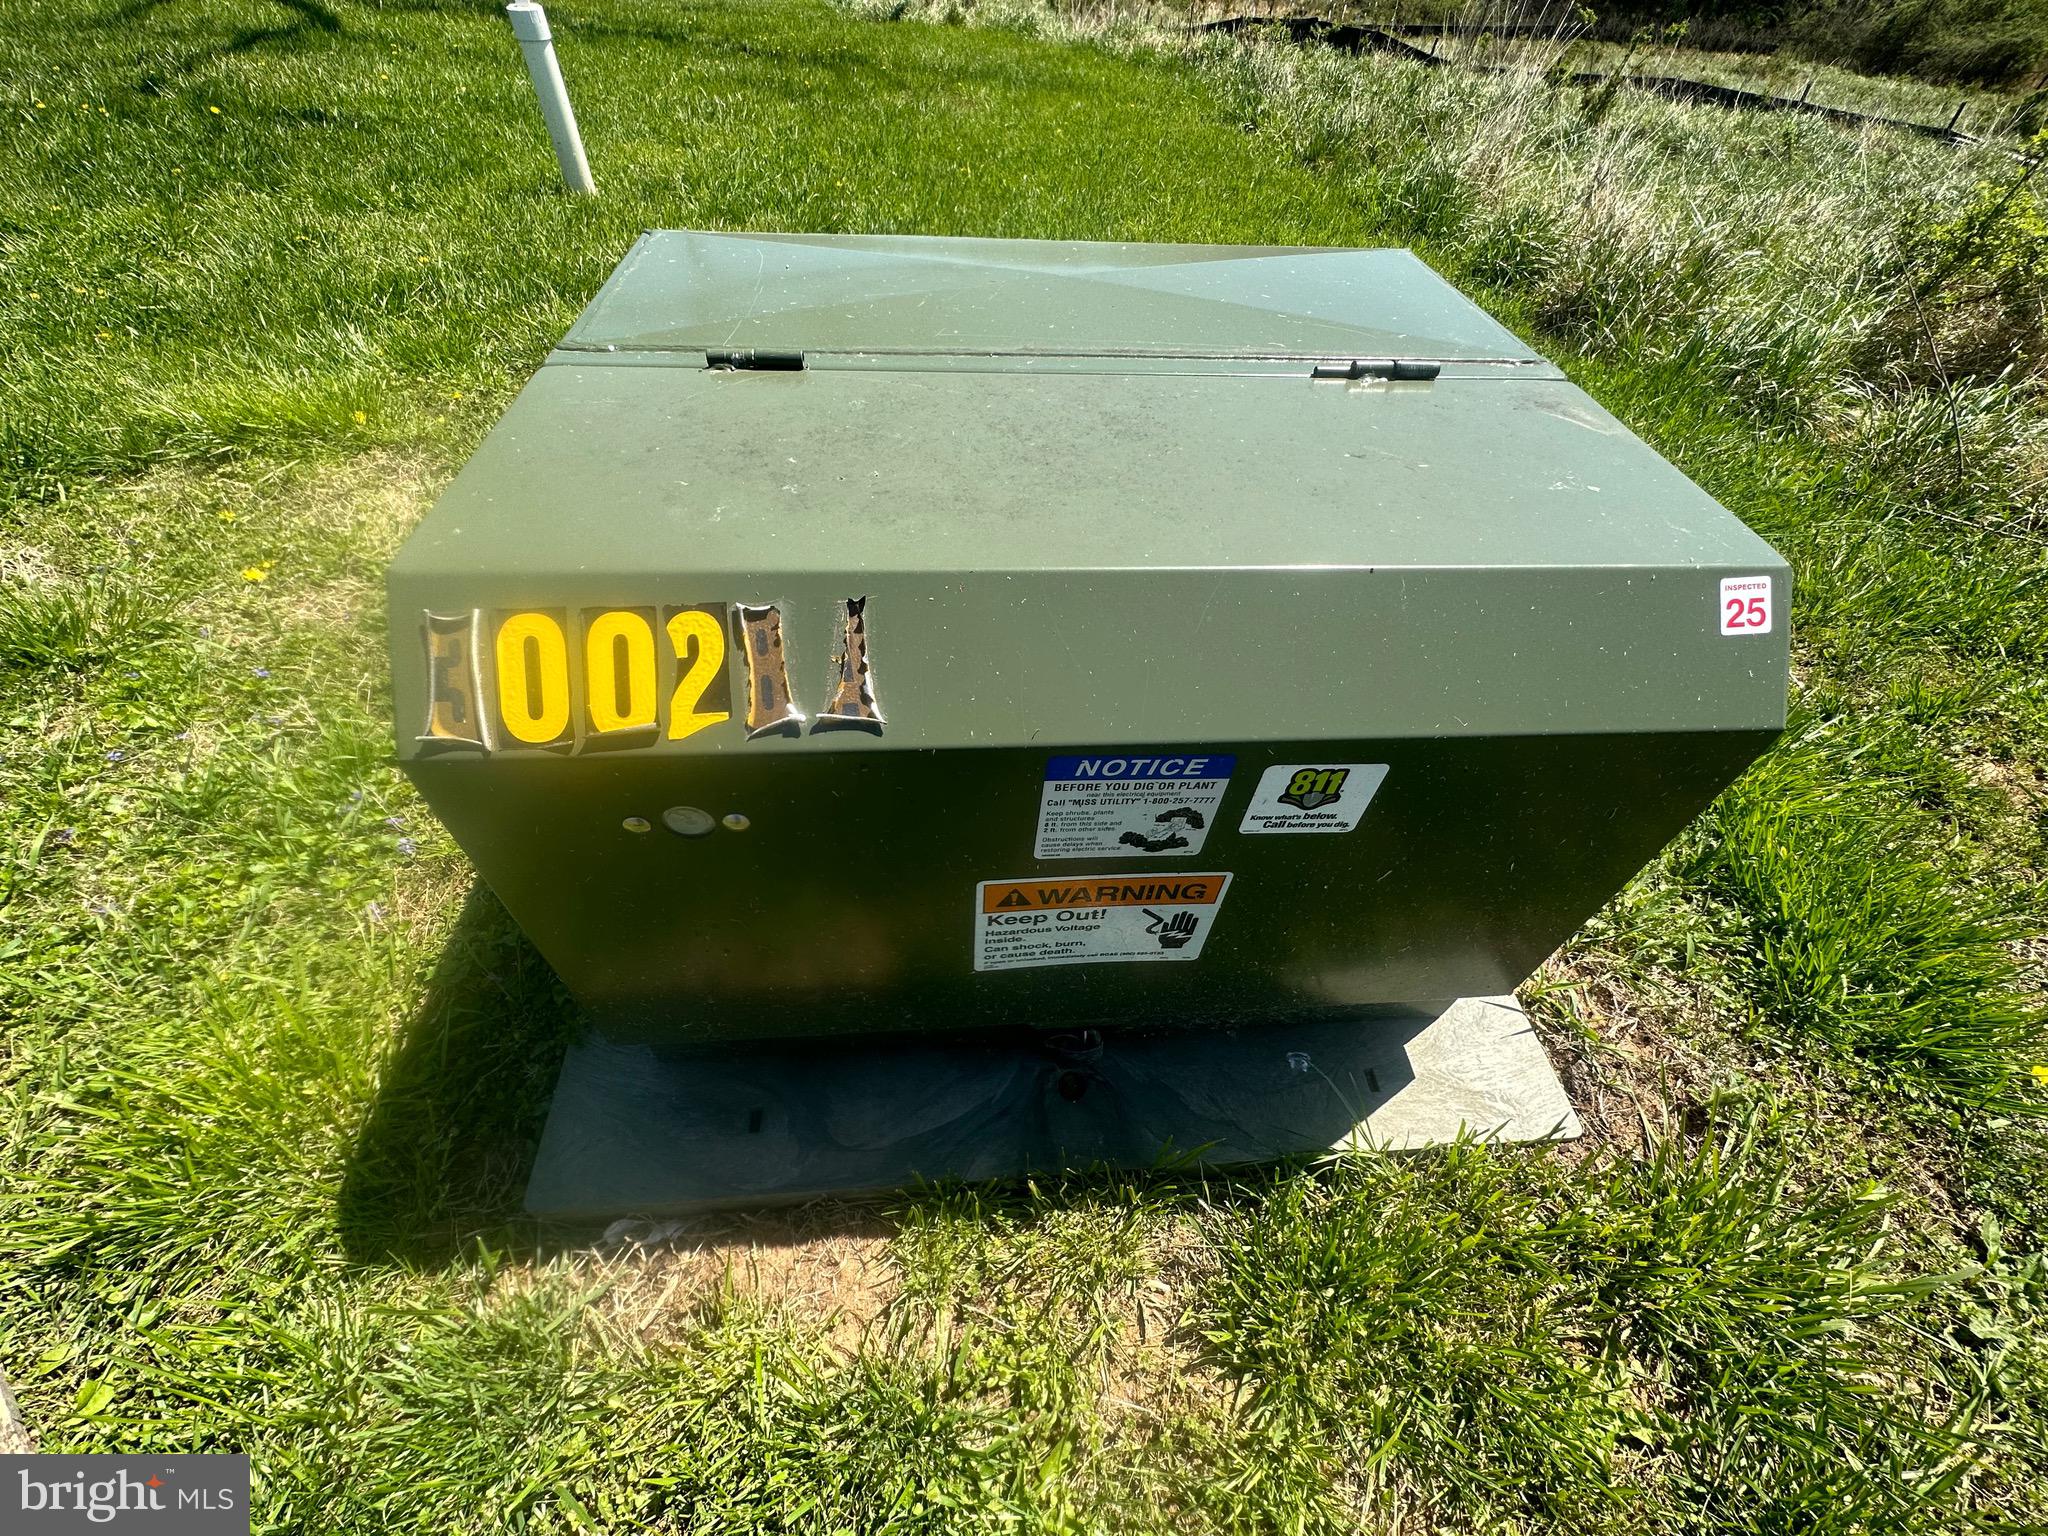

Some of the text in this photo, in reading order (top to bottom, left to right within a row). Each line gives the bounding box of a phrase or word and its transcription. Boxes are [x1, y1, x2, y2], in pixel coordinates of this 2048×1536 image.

[1725, 583, 1767, 591] INSPECTED
[1726, 597, 1767, 628] 25
[1074, 758, 1209, 777] NOTICE
[1054, 781, 1218, 792] BEFORE YOU DIG OR PLANT
[1289, 770, 1346, 795] 811
[1047, 797, 1216, 807] Call "MISS UTILITY" 1-800-257-7777
[1302, 812, 1337, 820] below.
[1262, 820, 1287, 829] Call
[1333, 821, 1350, 829] dig.
[1038, 883, 1208, 905] WARNING
[986, 908, 1108, 927] Keep Out!
[985, 924, 1101, 937] Hazardous Voltage
[1011, 942, 1052, 951] shock,
[1055, 941, 1086, 949] burn,
[999, 951, 1036, 959] cause
[1039, 948, 1076, 956] death.
